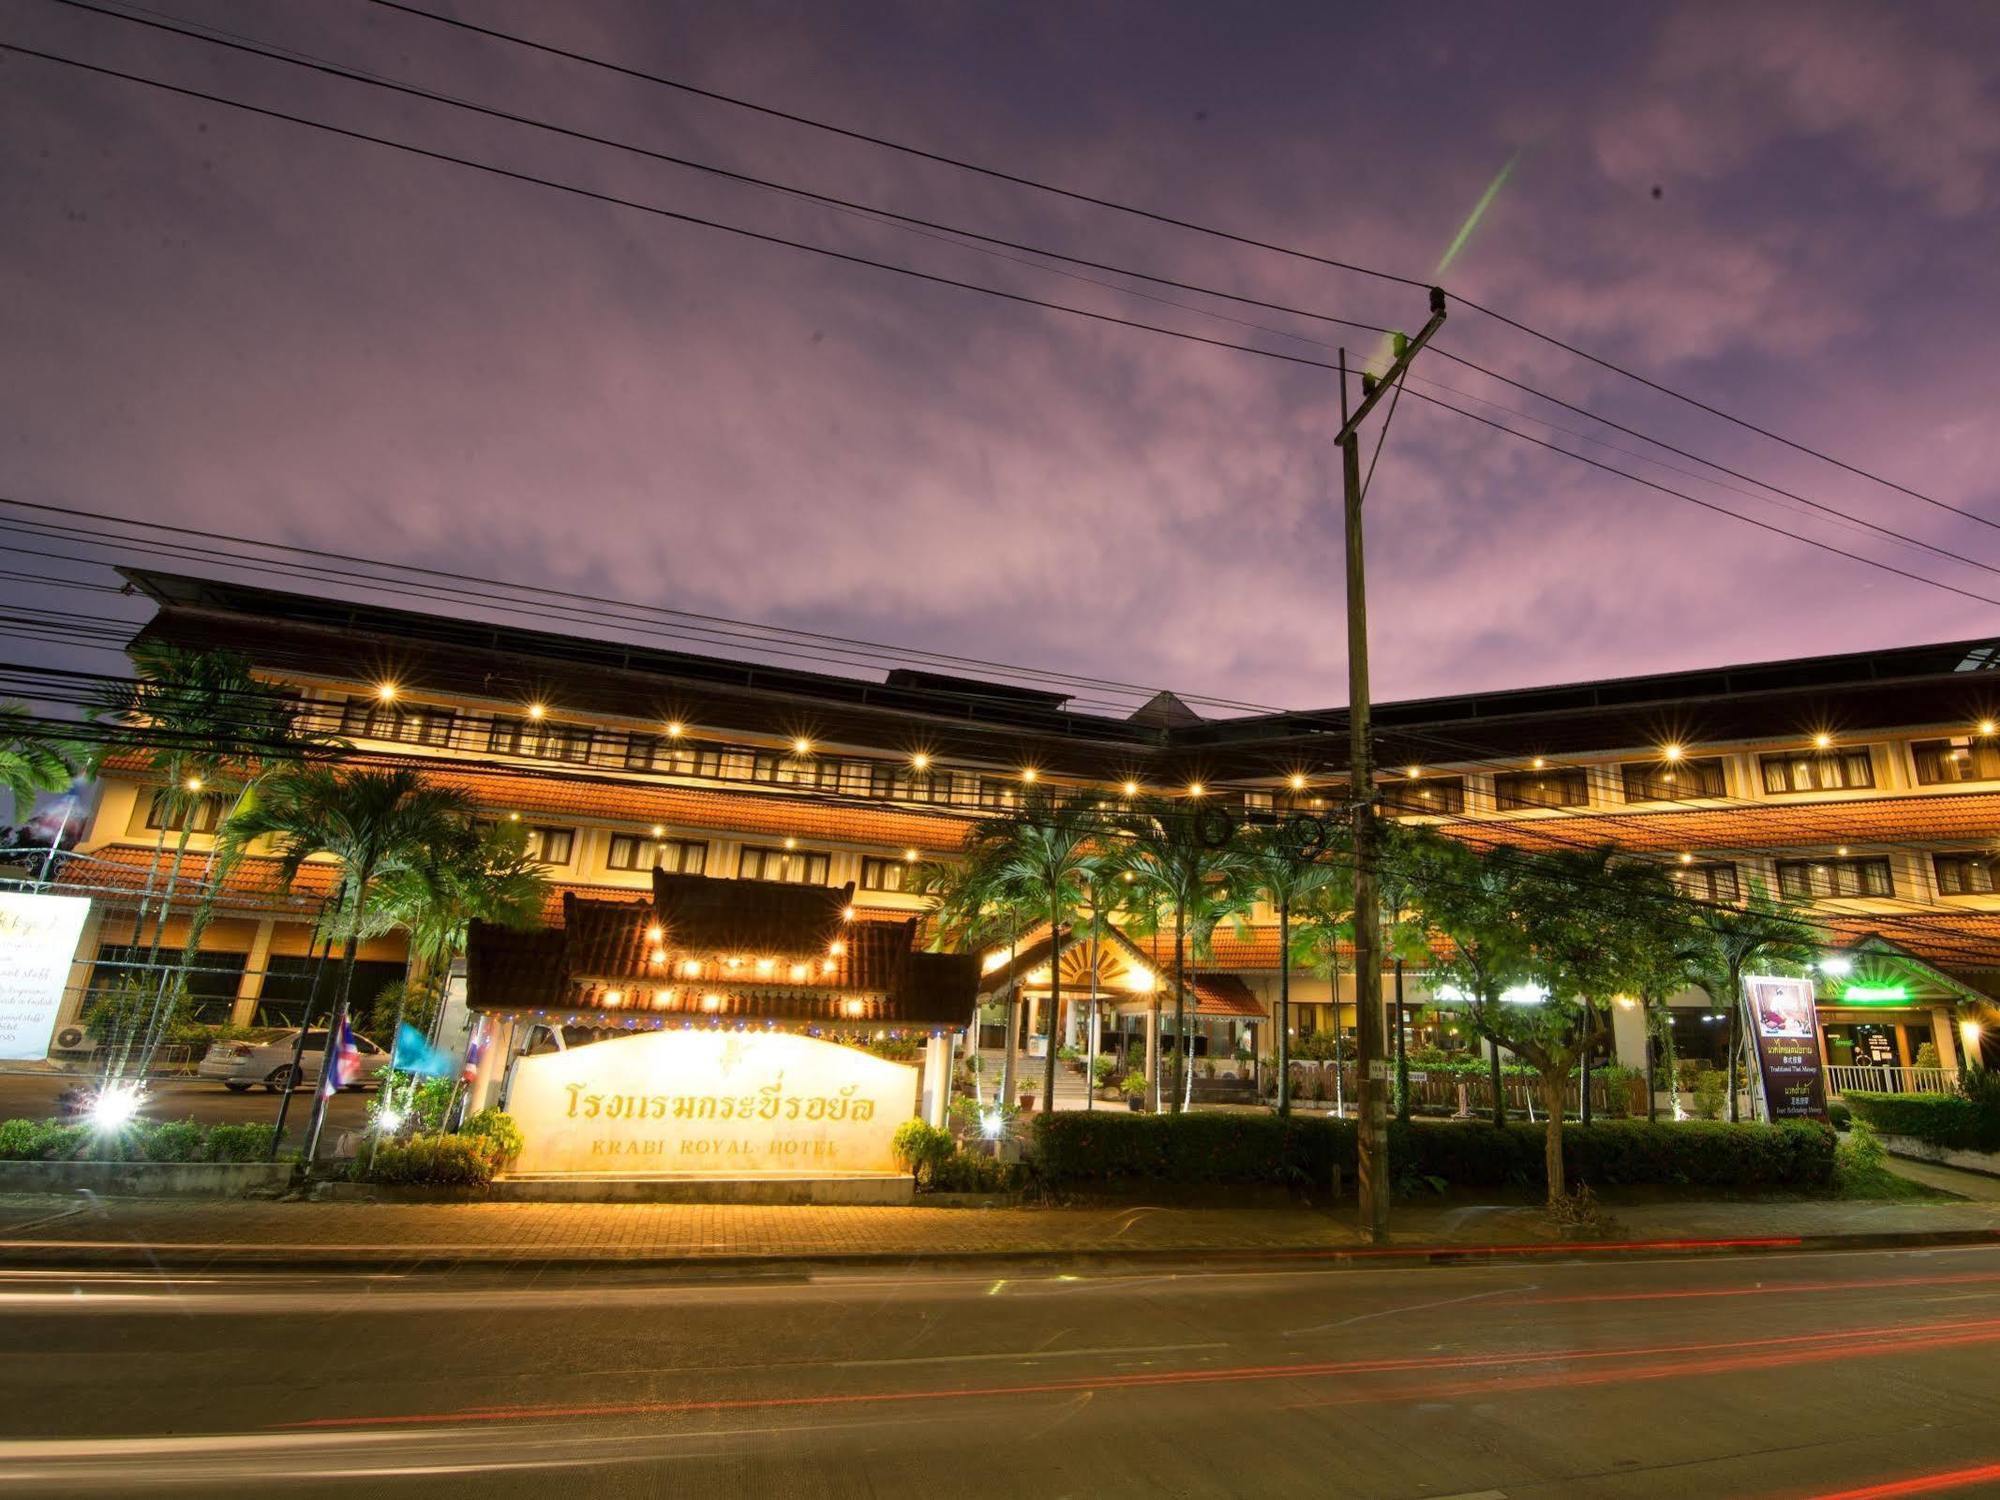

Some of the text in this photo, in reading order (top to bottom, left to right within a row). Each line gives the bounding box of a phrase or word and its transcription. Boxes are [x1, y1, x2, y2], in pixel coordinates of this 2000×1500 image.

[565, 1070, 875, 1121] โรงแรมกระบี่รอยัล
[592, 1140, 841, 1156] KRABI ROYAL HOTEL
